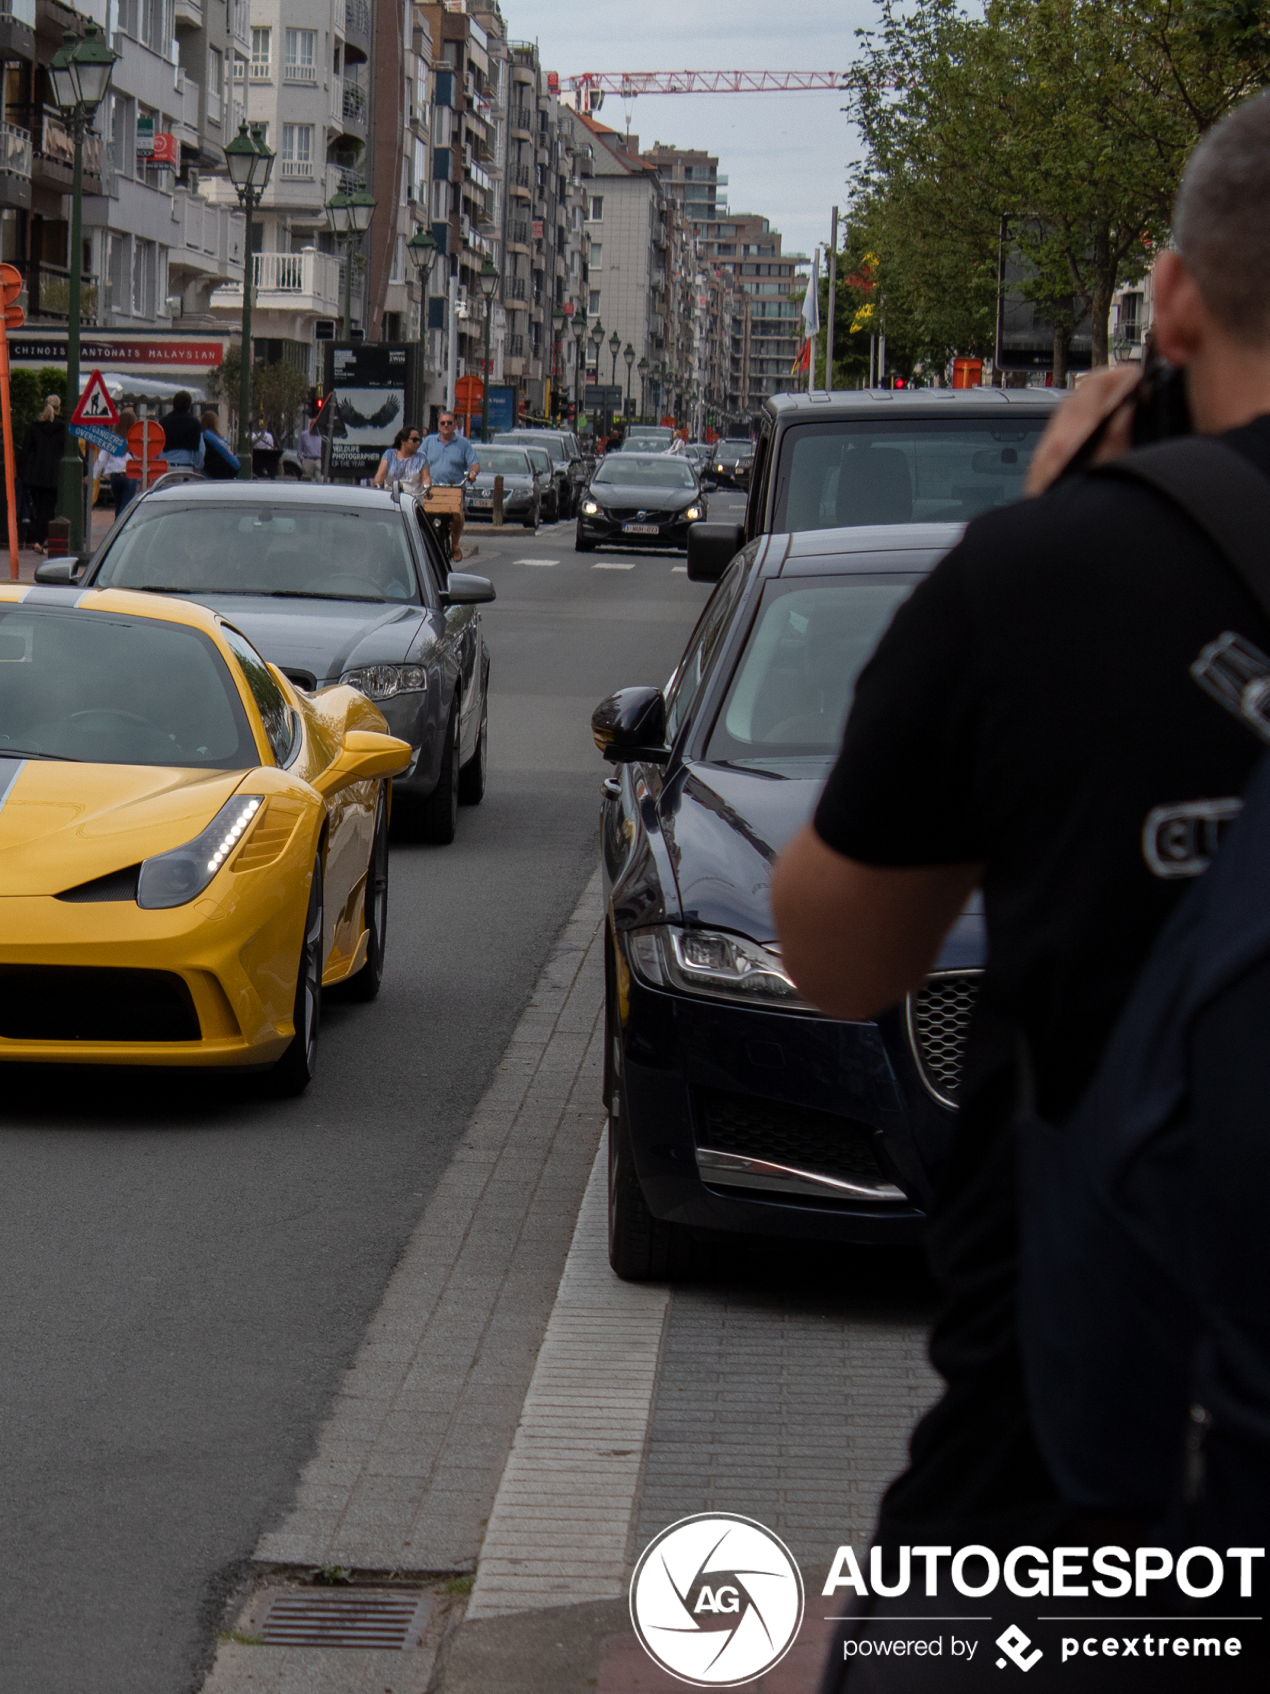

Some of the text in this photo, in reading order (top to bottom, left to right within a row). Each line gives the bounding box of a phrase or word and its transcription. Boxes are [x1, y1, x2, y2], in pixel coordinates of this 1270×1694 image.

[14, 346, 66, 356] CHINOIS
[148, 349, 215, 360] MALAYSIAN
[75, 427, 118, 454] OVERSTEKEN
[332, 445, 360, 453] WILDLIFE
[331, 452, 381, 461] PHOTOGRAPHER
[331, 460, 366, 469] OF THE YEAR
